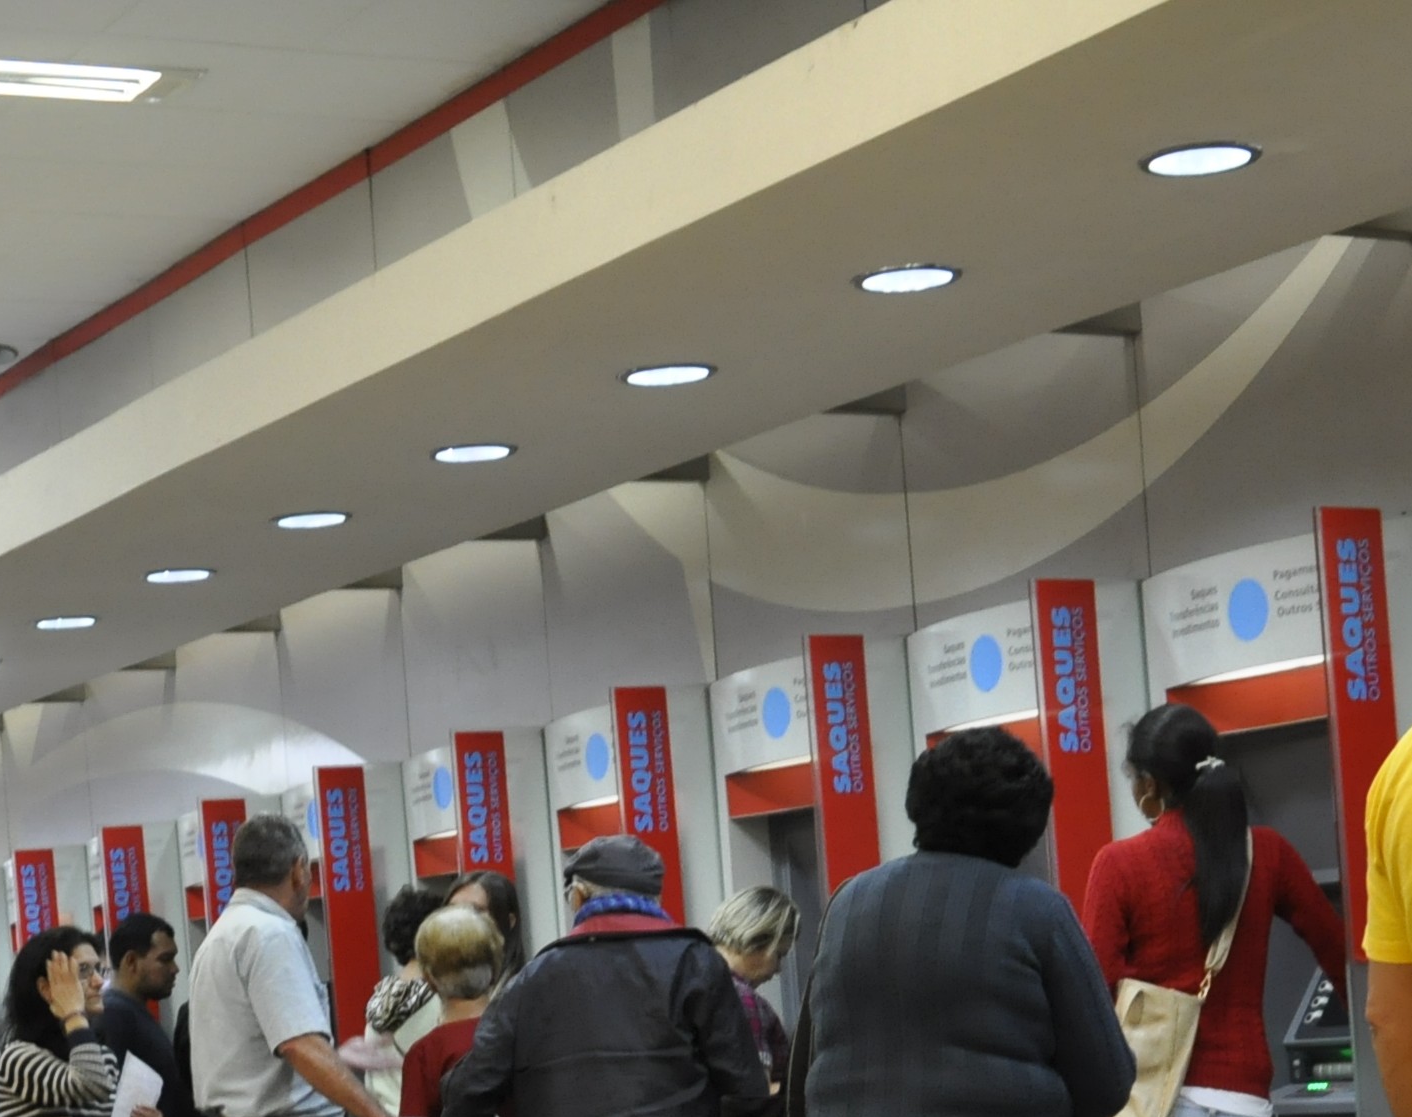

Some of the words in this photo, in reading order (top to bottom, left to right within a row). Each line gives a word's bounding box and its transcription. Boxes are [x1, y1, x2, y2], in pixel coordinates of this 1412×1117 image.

[1336, 537, 1368, 702] SAQUES
[1357, 537, 1376, 623] SERVIÇOS
[1050, 605, 1080, 754] SAQUES
[1070, 606, 1087, 682] SERVIÇOS
[1363, 627, 1381, 702] OUTROS
[822, 661, 852, 794] SAQUES
[842, 661, 858, 729] SERVIÇOS
[1077, 687, 1092, 753] OUTROS
[627, 710, 654, 833] SAQUES
[848, 733, 864, 793] OUTROS
[325, 787, 351, 892] SAQUES
[463, 751, 489, 864] SAQUES
[21, 864, 41, 938] AQUES
[110, 847, 130, 921] AQUES
